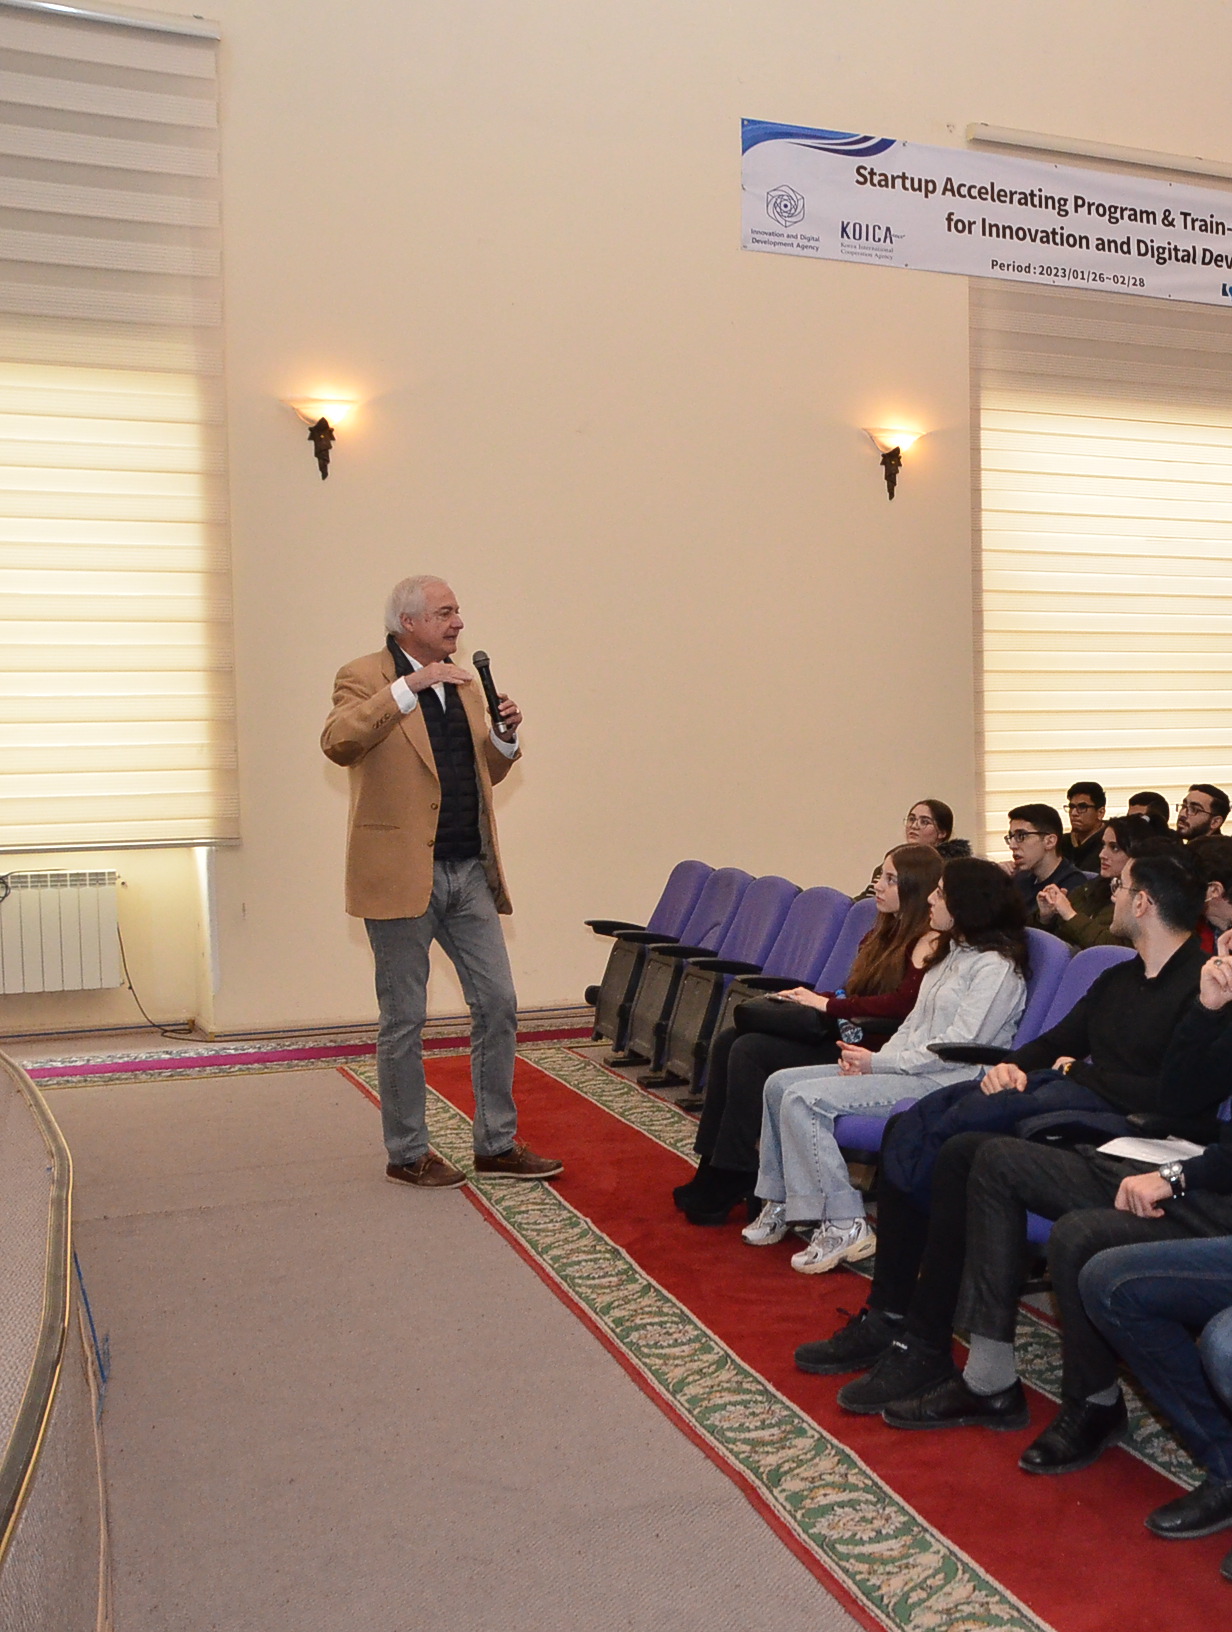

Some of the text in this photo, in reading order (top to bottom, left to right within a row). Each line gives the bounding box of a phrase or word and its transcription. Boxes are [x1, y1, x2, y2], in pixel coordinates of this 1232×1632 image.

[855, 164, 938, 199] Startup
[941, 176, 1070, 218] Accelerating
[1073, 194, 1157, 225] Program
[1161, 208, 1176, 228] &
[750, 228, 785, 238] Innovation
[800, 234, 820, 243] Digital
[751, 237, 820, 252] Development Agency
[840, 220, 894, 245] KOICA
[945, 211, 976, 235] for
[981, 217, 1091, 250] Innovation
[1094, 236, 1132, 256] and
[1136, 238, 1197, 265] Digital
